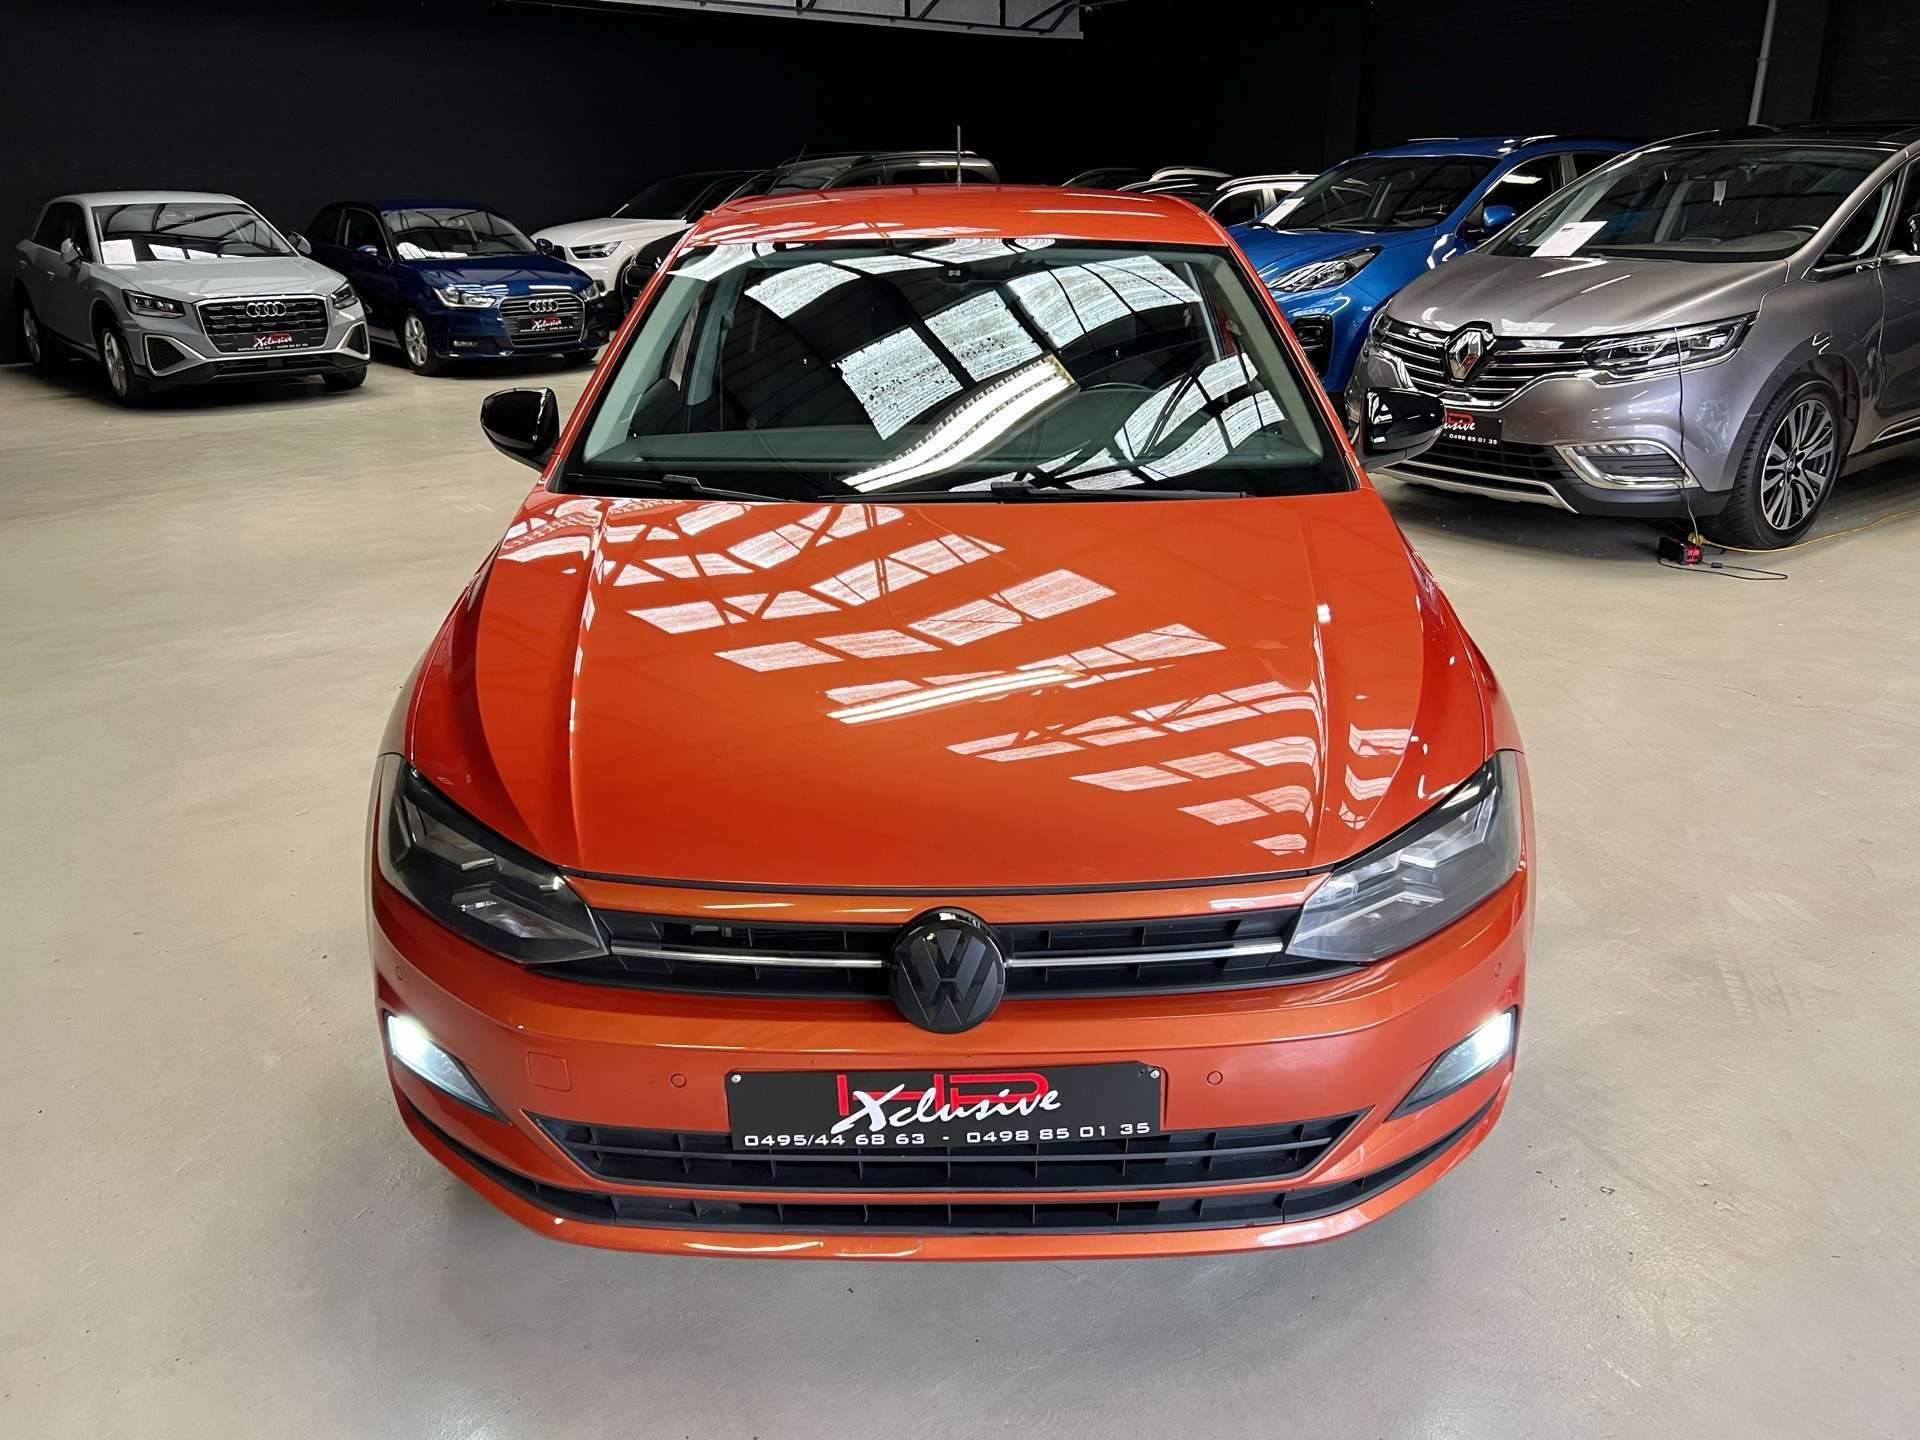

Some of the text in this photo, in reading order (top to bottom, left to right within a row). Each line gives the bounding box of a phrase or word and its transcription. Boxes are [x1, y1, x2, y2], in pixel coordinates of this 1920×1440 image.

[1443, 419, 1476, 431] usive
[830, 1083, 1061, 1135] Xclusive
[744, 1133, 846, 1147] 0495/44
[855, 1133, 886, 1146] 68
[895, 1132, 925, 1145] 63
[966, 1129, 1030, 1144] 0498
[1039, 1127, 1070, 1140] 85
[1079, 1125, 1106, 1138] 01
[1119, 1121, 1151, 1135] 35
